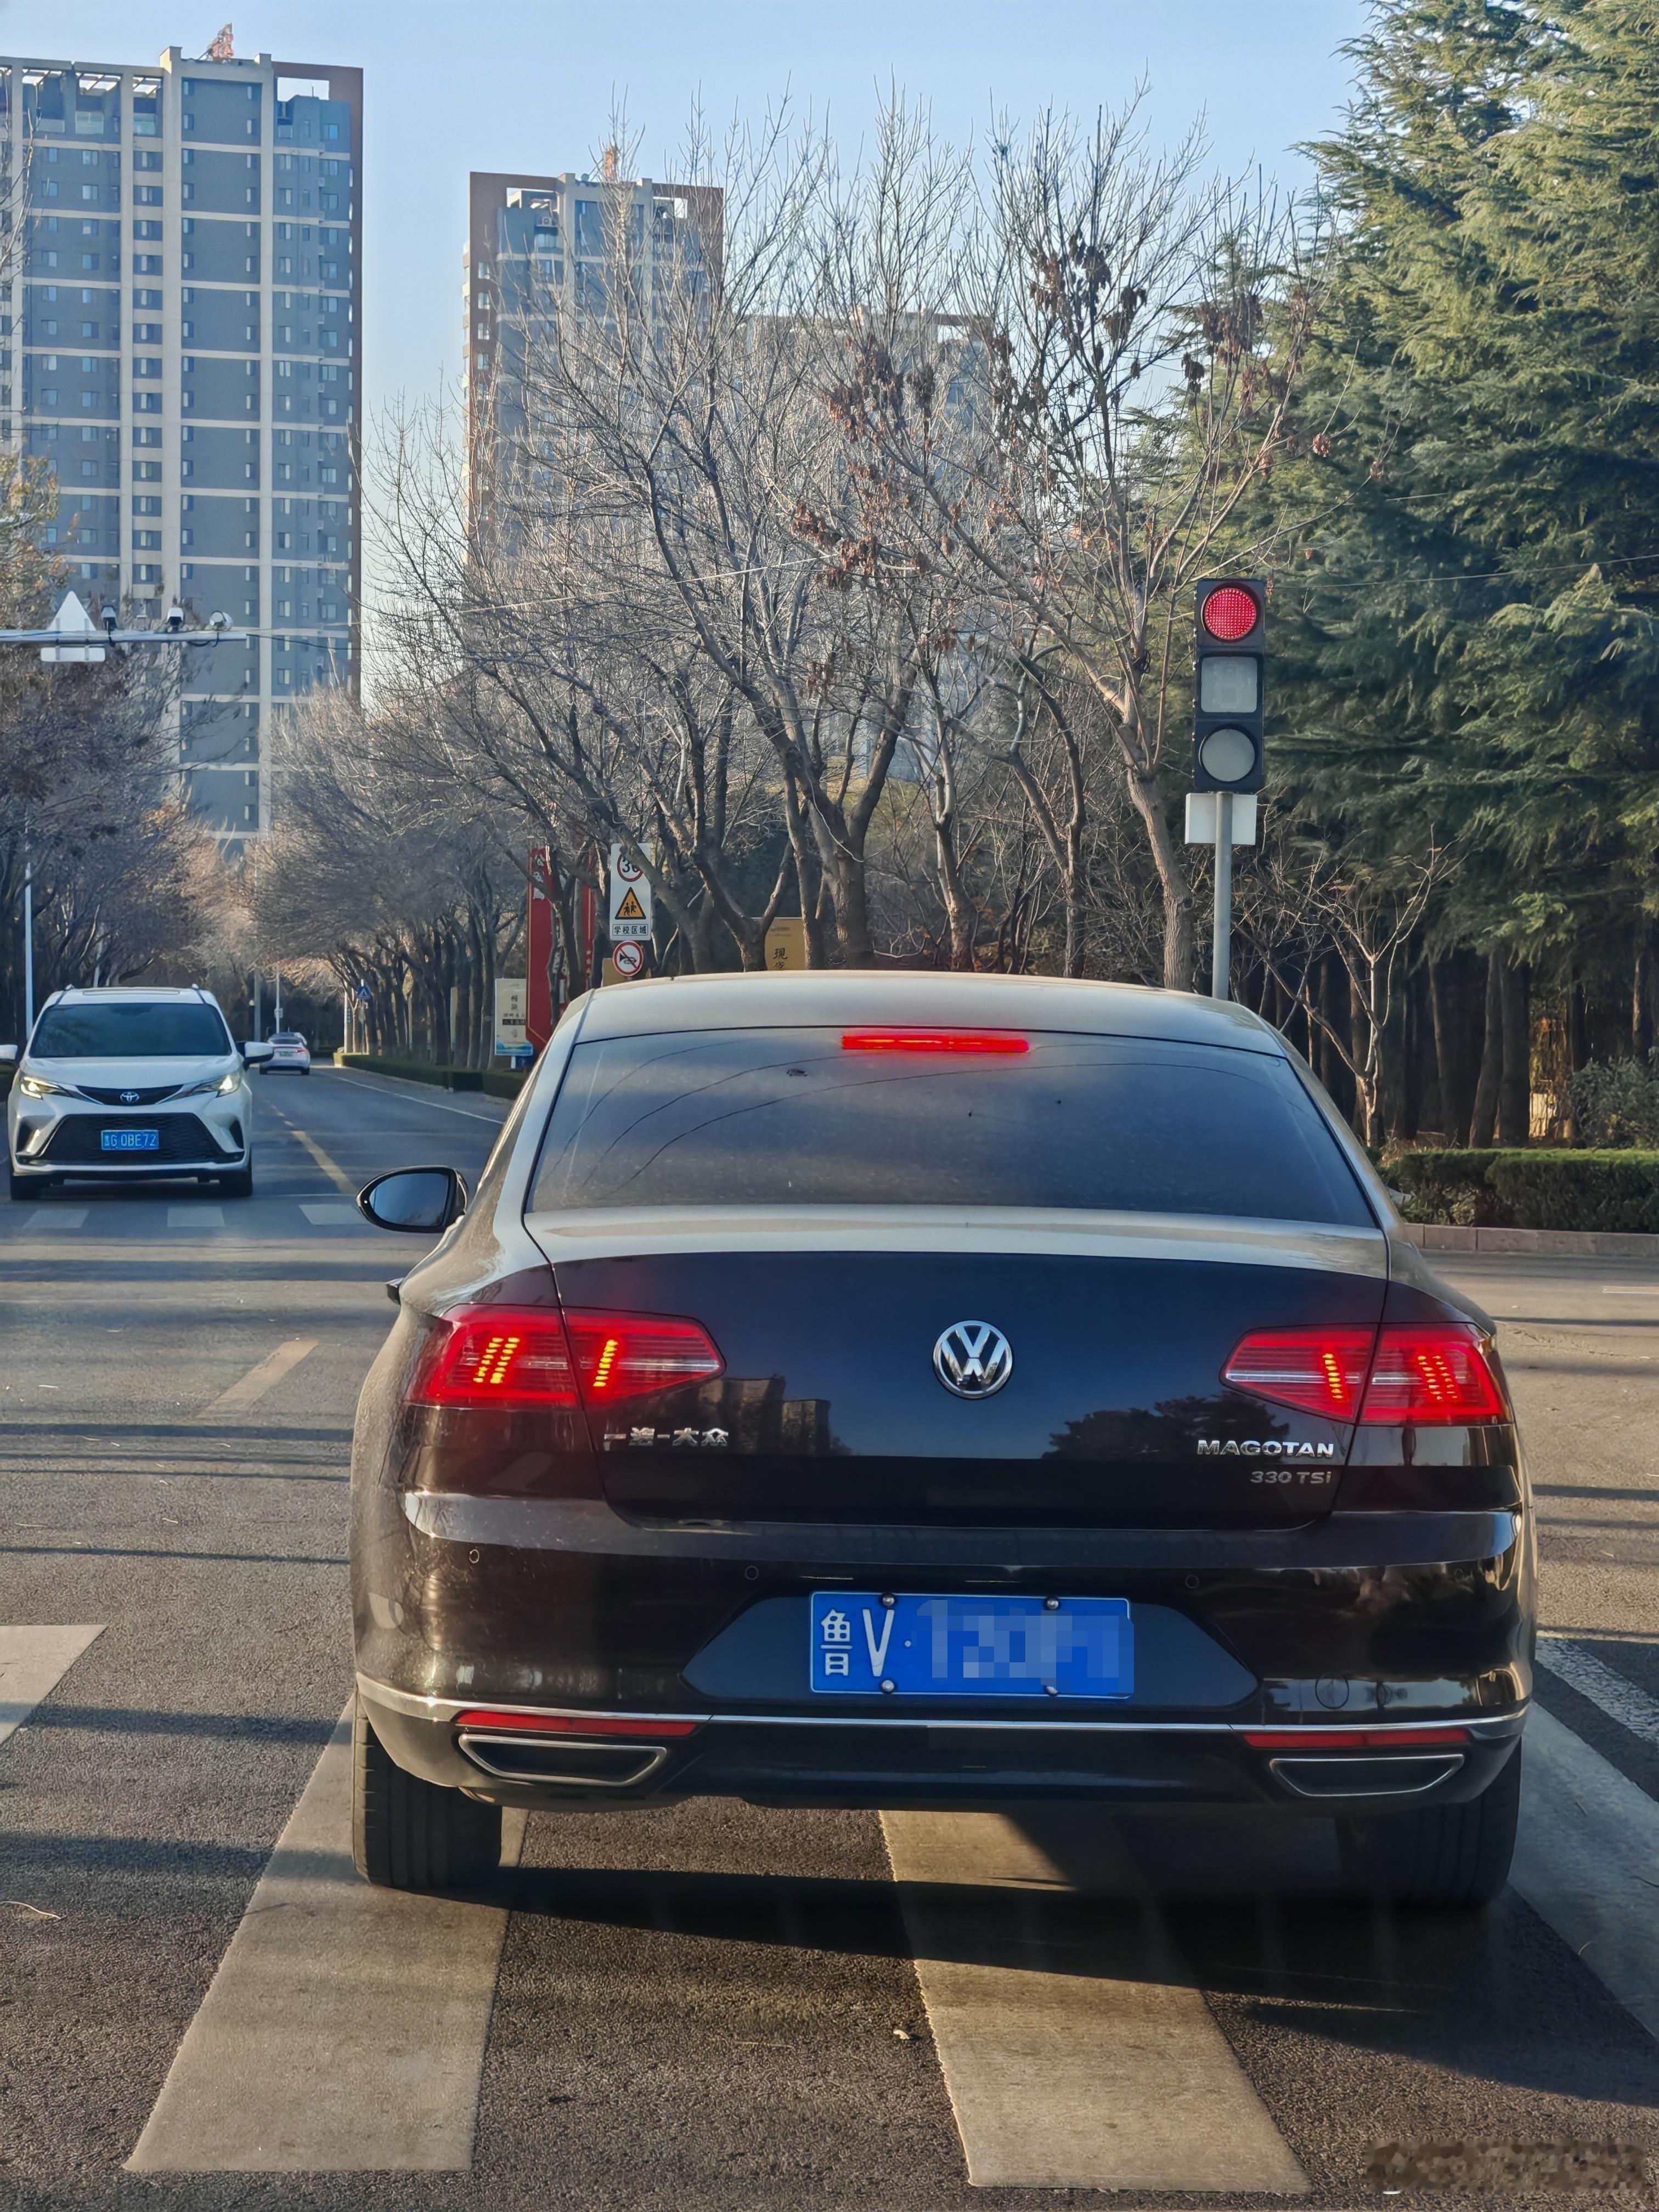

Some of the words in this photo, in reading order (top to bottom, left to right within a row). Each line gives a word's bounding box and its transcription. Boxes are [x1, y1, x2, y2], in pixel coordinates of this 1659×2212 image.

[614, 926, 647, 935] 学校区域
[1197, 1440, 1334, 1458] MAGOTAN
[1250, 1471, 1292, 1484] 330
